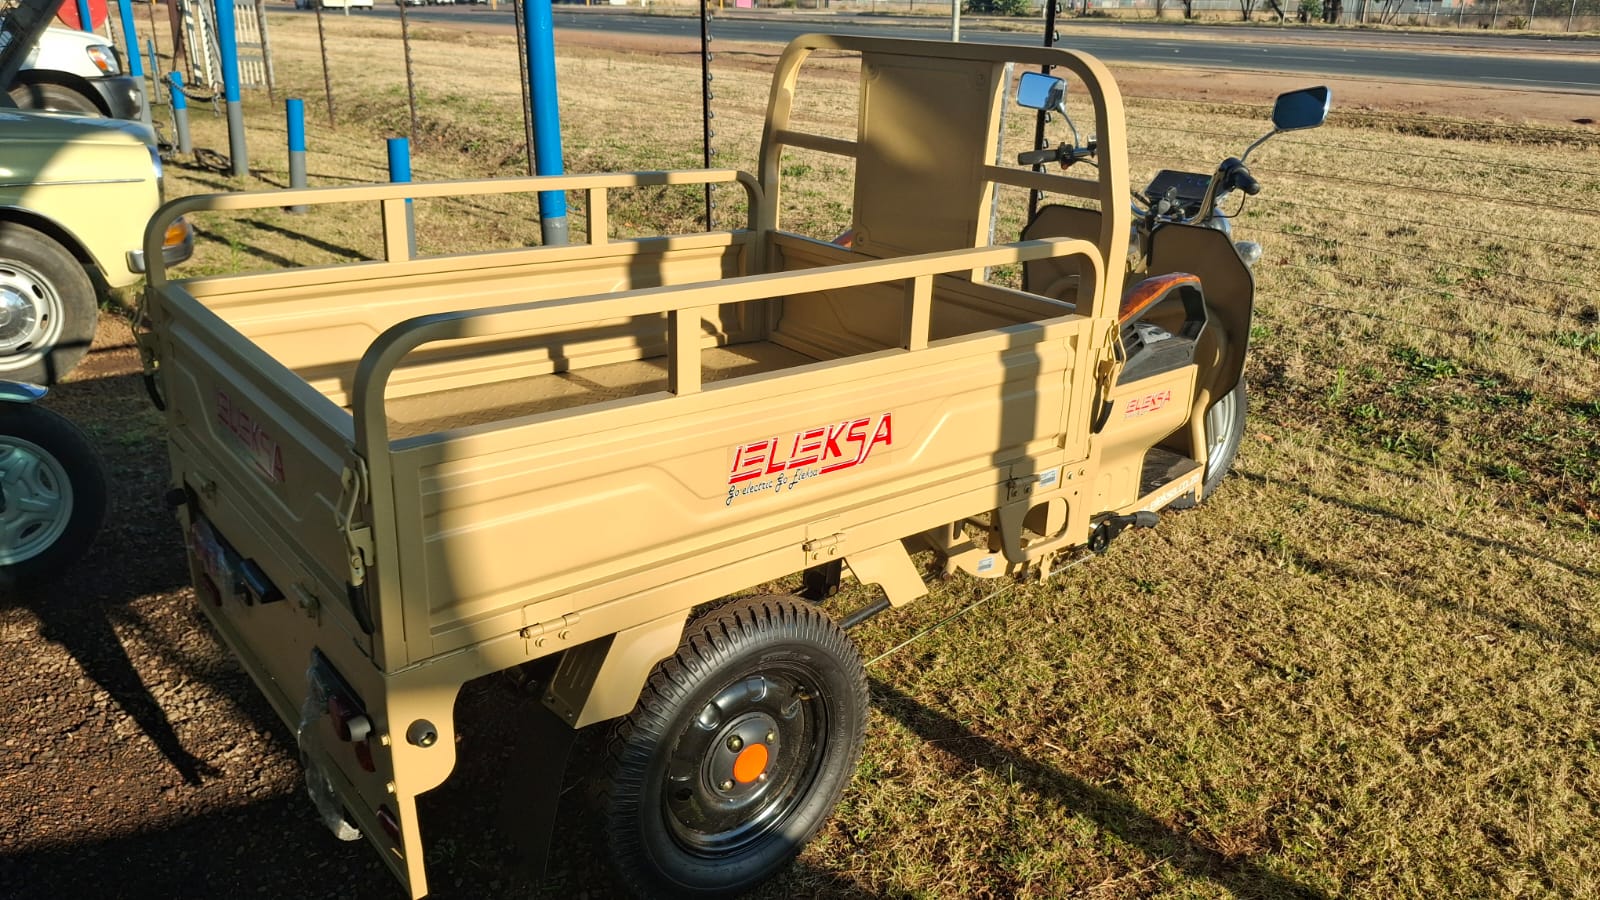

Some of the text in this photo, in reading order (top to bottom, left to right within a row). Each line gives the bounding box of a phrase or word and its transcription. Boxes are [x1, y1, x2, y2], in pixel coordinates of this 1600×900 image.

[1125, 390, 1171, 413] ELEKSA
[728, 412, 892, 484] ELEKSA
[726, 485, 740, 506] Go
[742, 481, 773, 495] electric
[775, 472, 788, 493] Go
